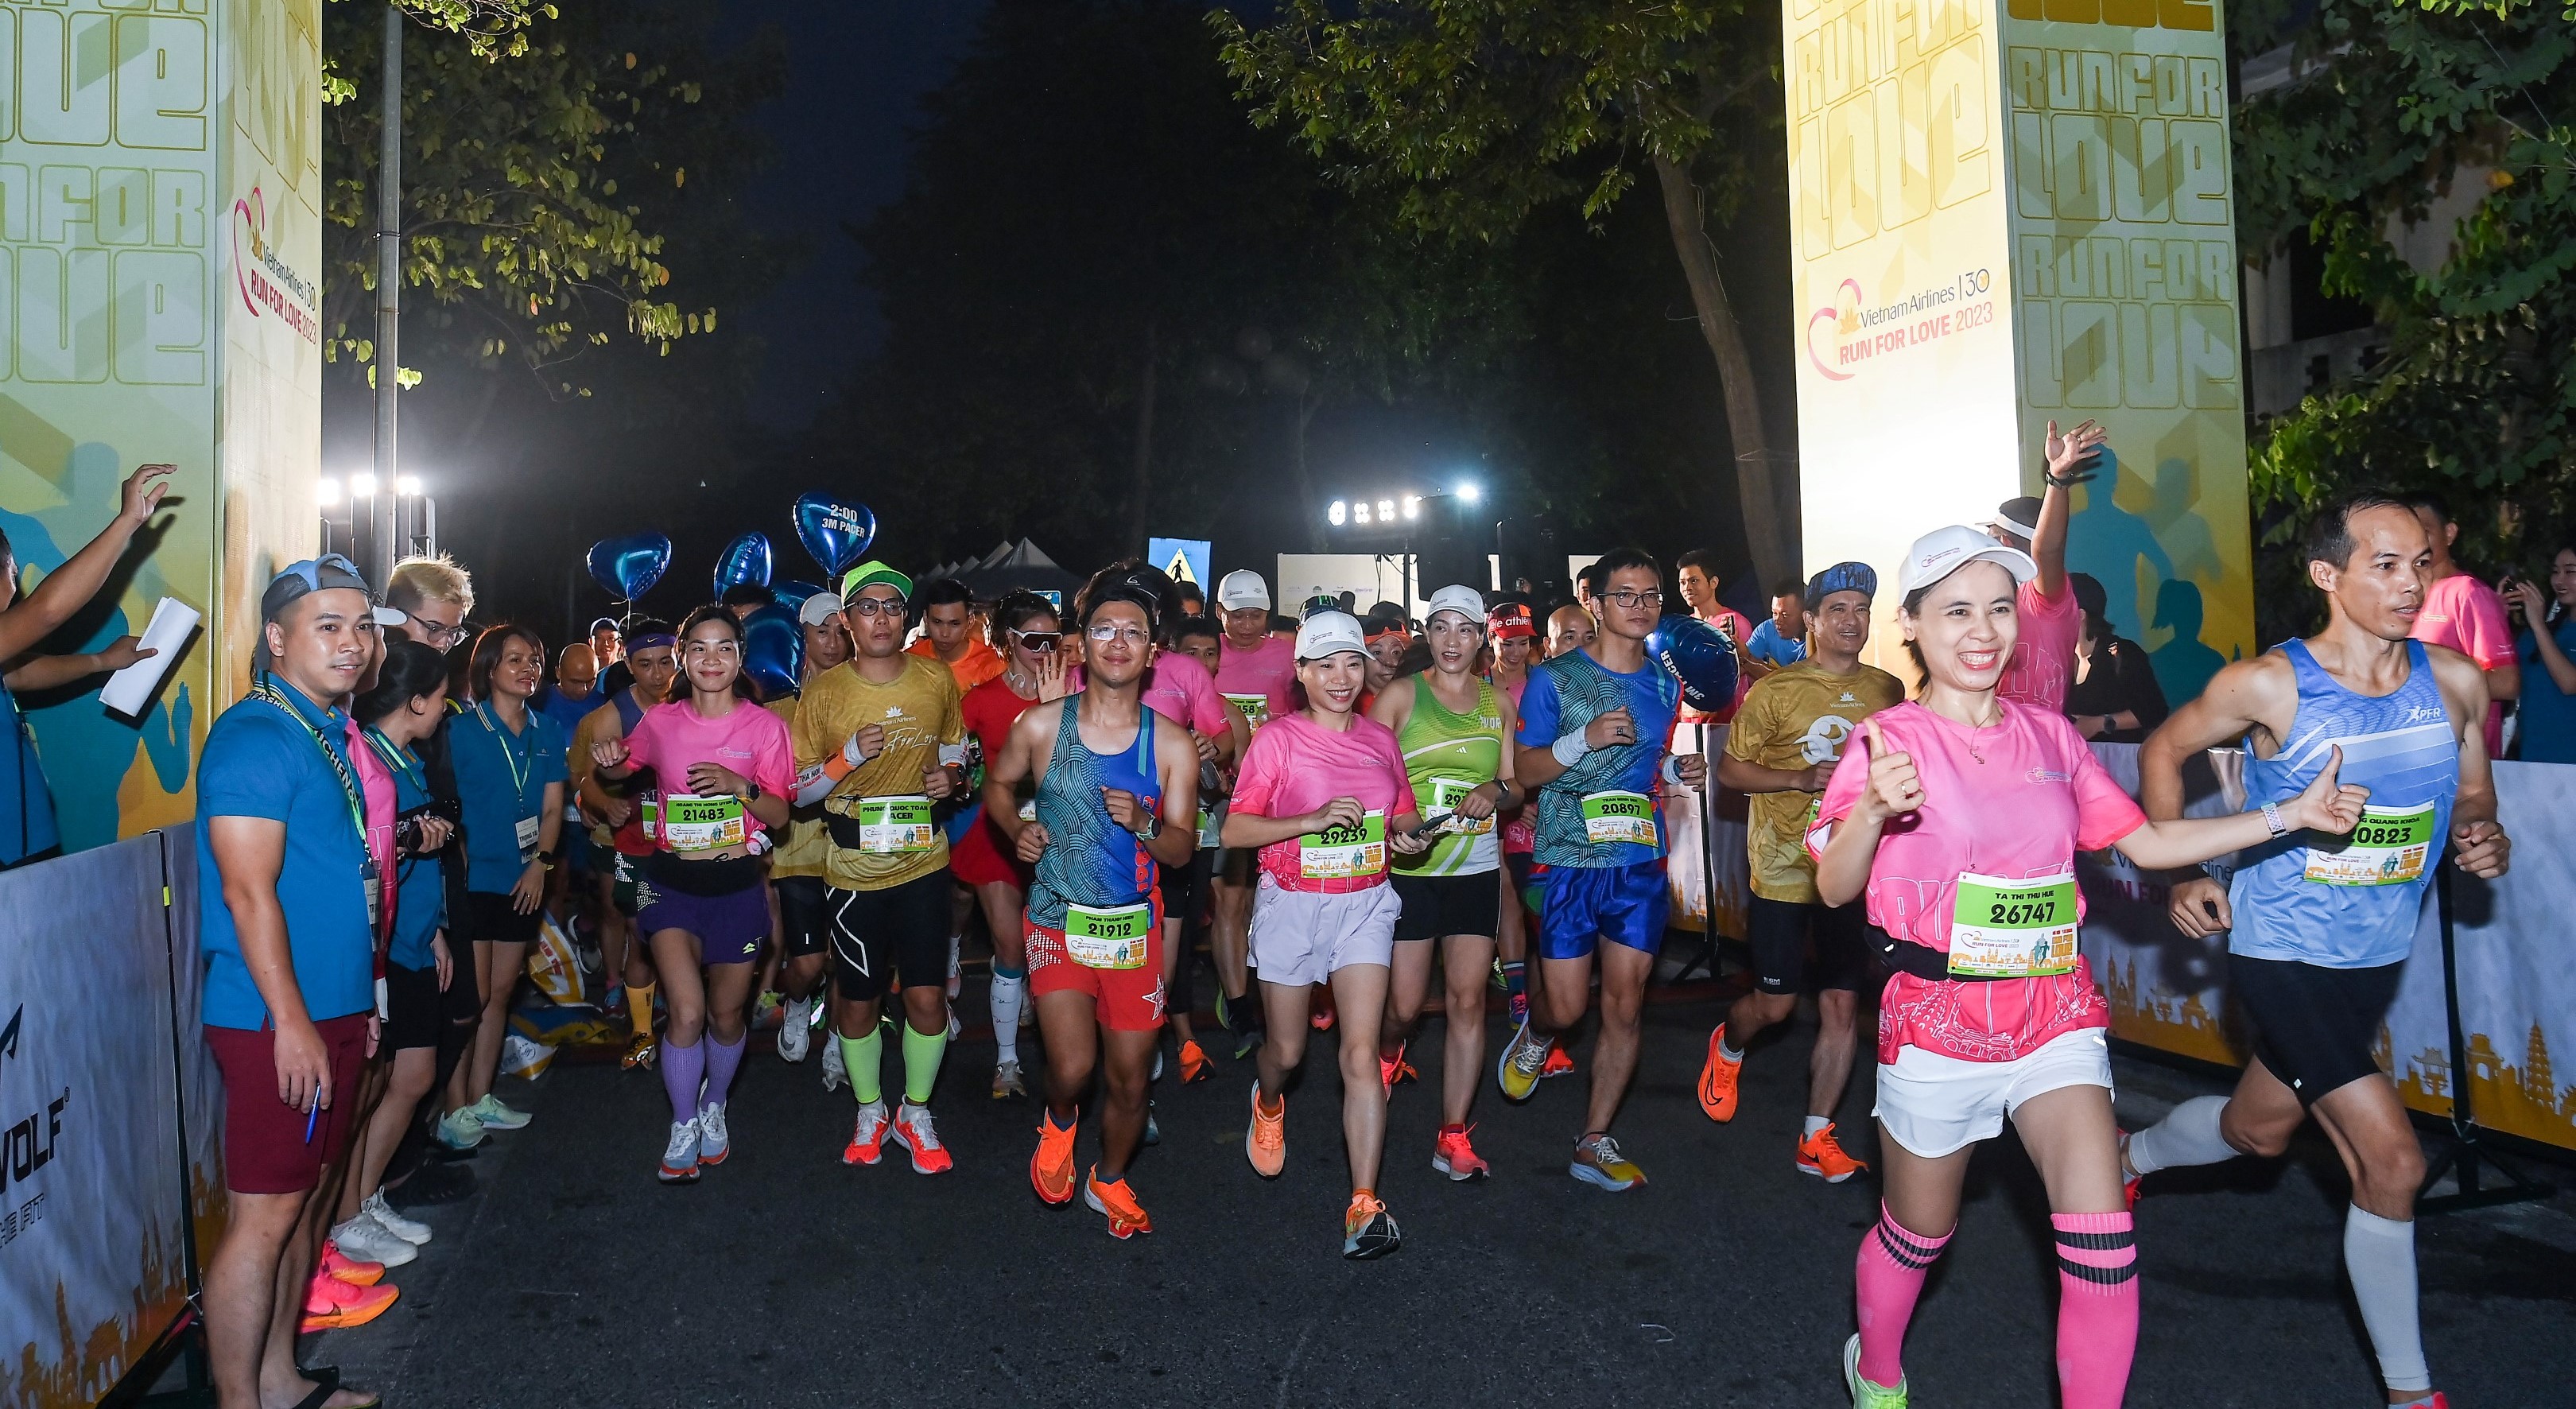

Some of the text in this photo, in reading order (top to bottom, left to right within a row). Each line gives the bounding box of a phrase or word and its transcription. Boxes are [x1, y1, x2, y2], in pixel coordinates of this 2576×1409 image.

[251, 268, 316, 345] RUN FOR LOVE 2023
[1839, 301, 1993, 366] RUN FOR LOVE 2023
[830, 503, 858, 522] 2:00
[821, 518, 865, 538] 3M PACER
[1659, 650, 1705, 701] 3M ACER
[683, 807, 725, 821] 21483
[1601, 803, 1641, 816] 20897
[1320, 828, 1368, 844] 29239
[1989, 901, 2055, 925] 26747
[1088, 922, 1131, 937] 21912
